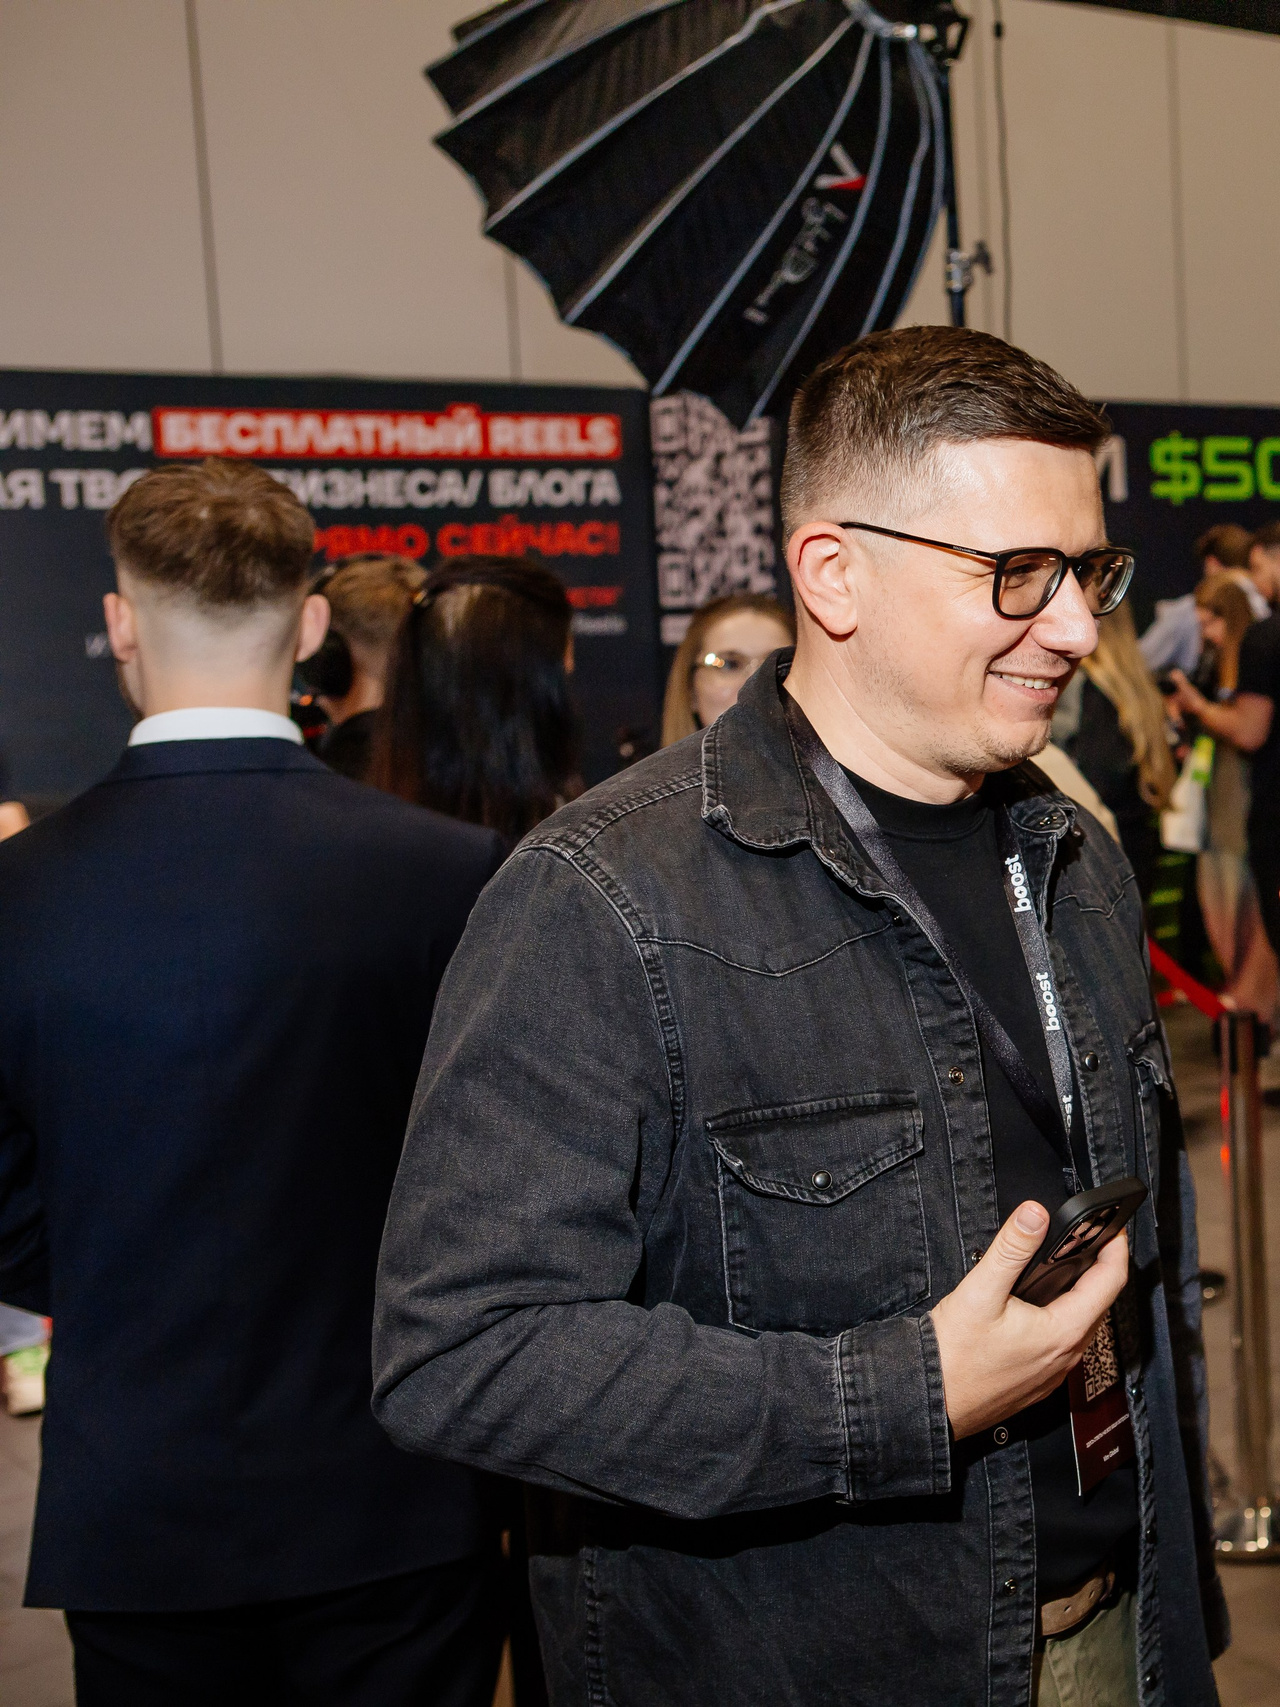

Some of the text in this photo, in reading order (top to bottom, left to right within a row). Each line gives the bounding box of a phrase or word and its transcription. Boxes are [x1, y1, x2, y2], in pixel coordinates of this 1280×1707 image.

[161, 403, 482, 455] БЕСПЛАТНЫЙ
[489, 415, 618, 456] REELS
[0, 468, 46, 511] Я
[488, 468, 621, 508] БЛОГА
[436, 513, 620, 558] СЕЙЧАС!
[1004, 853, 1032, 913] boost
[1036, 972, 1061, 1032] boost
